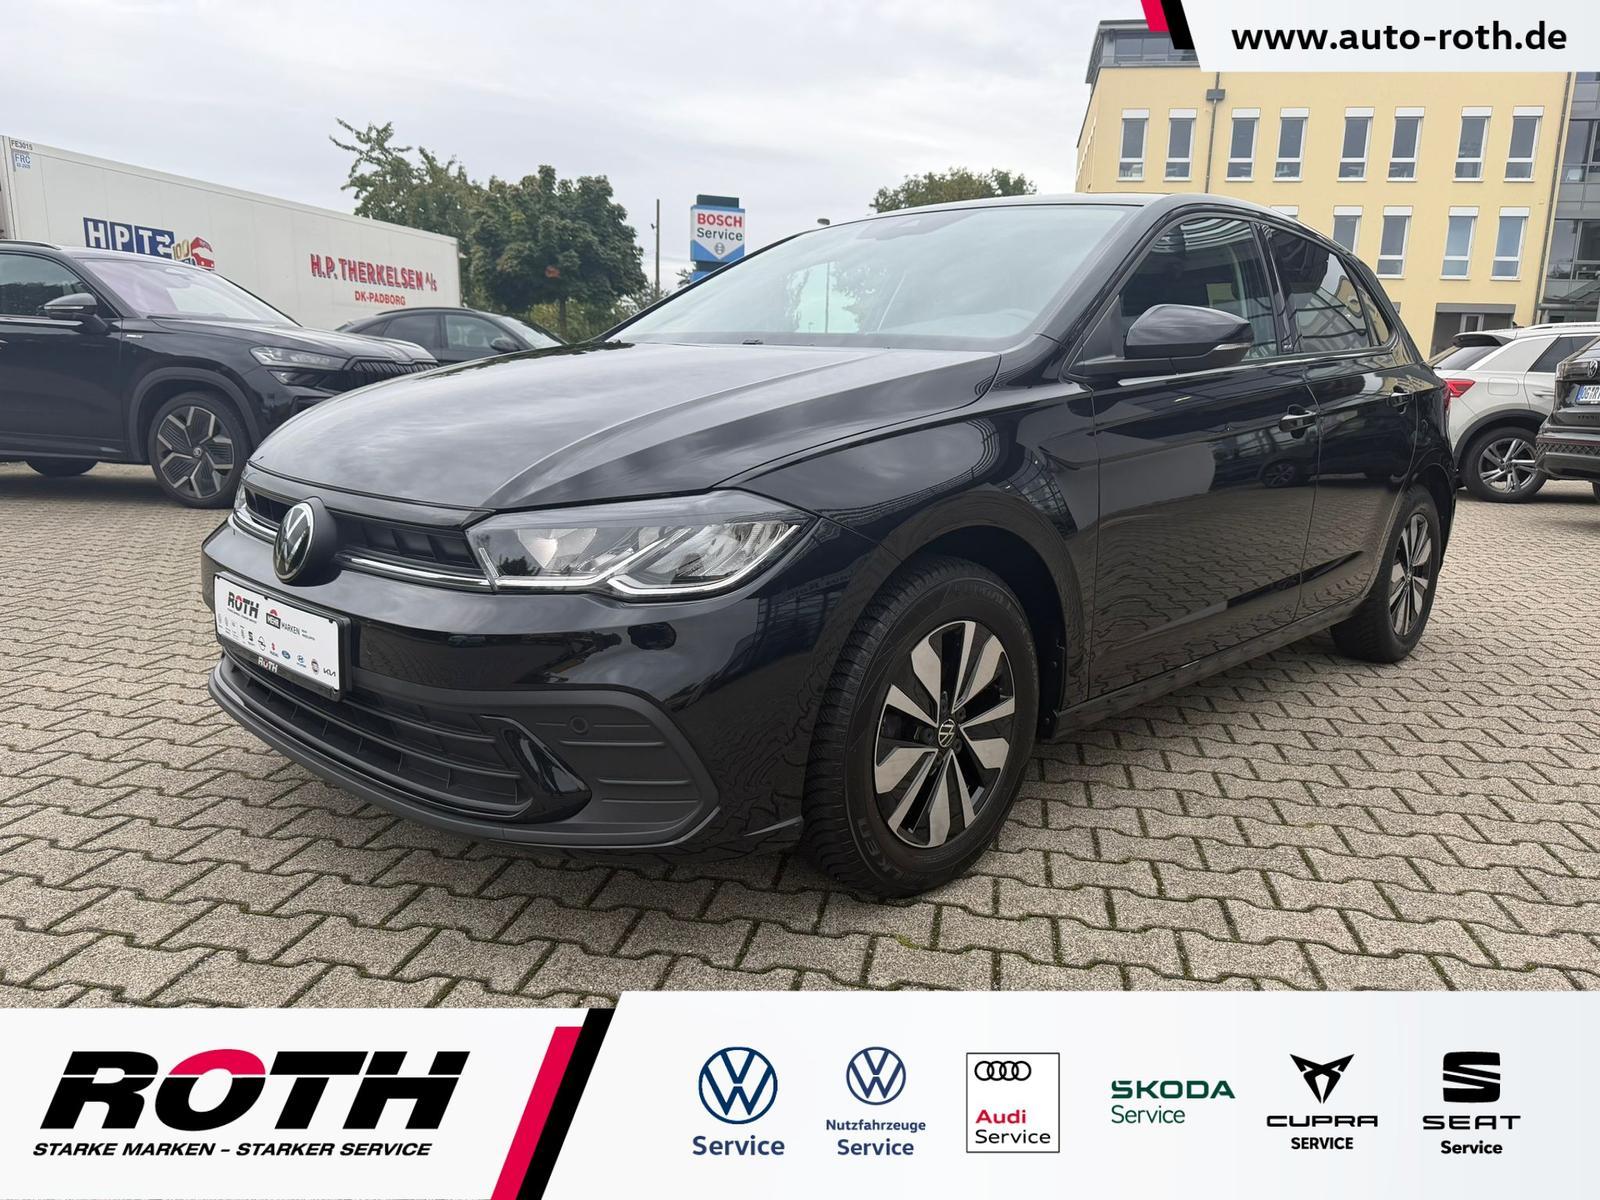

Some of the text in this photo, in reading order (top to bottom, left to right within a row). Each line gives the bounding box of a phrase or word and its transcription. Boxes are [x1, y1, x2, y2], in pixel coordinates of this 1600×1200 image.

[15, 153, 31, 164] FRC
[697, 213, 743, 227] BOSCH
[87, 221, 152, 254] HPT
[697, 228, 743, 241] Service
[310, 254, 338, 280] H.P.
[338, 258, 424, 291] THERKELSEN
[354, 291, 406, 306] DK-PADBORG
[227, 591, 260, 618] ROTH
[258, 656, 278, 673] ROTH
